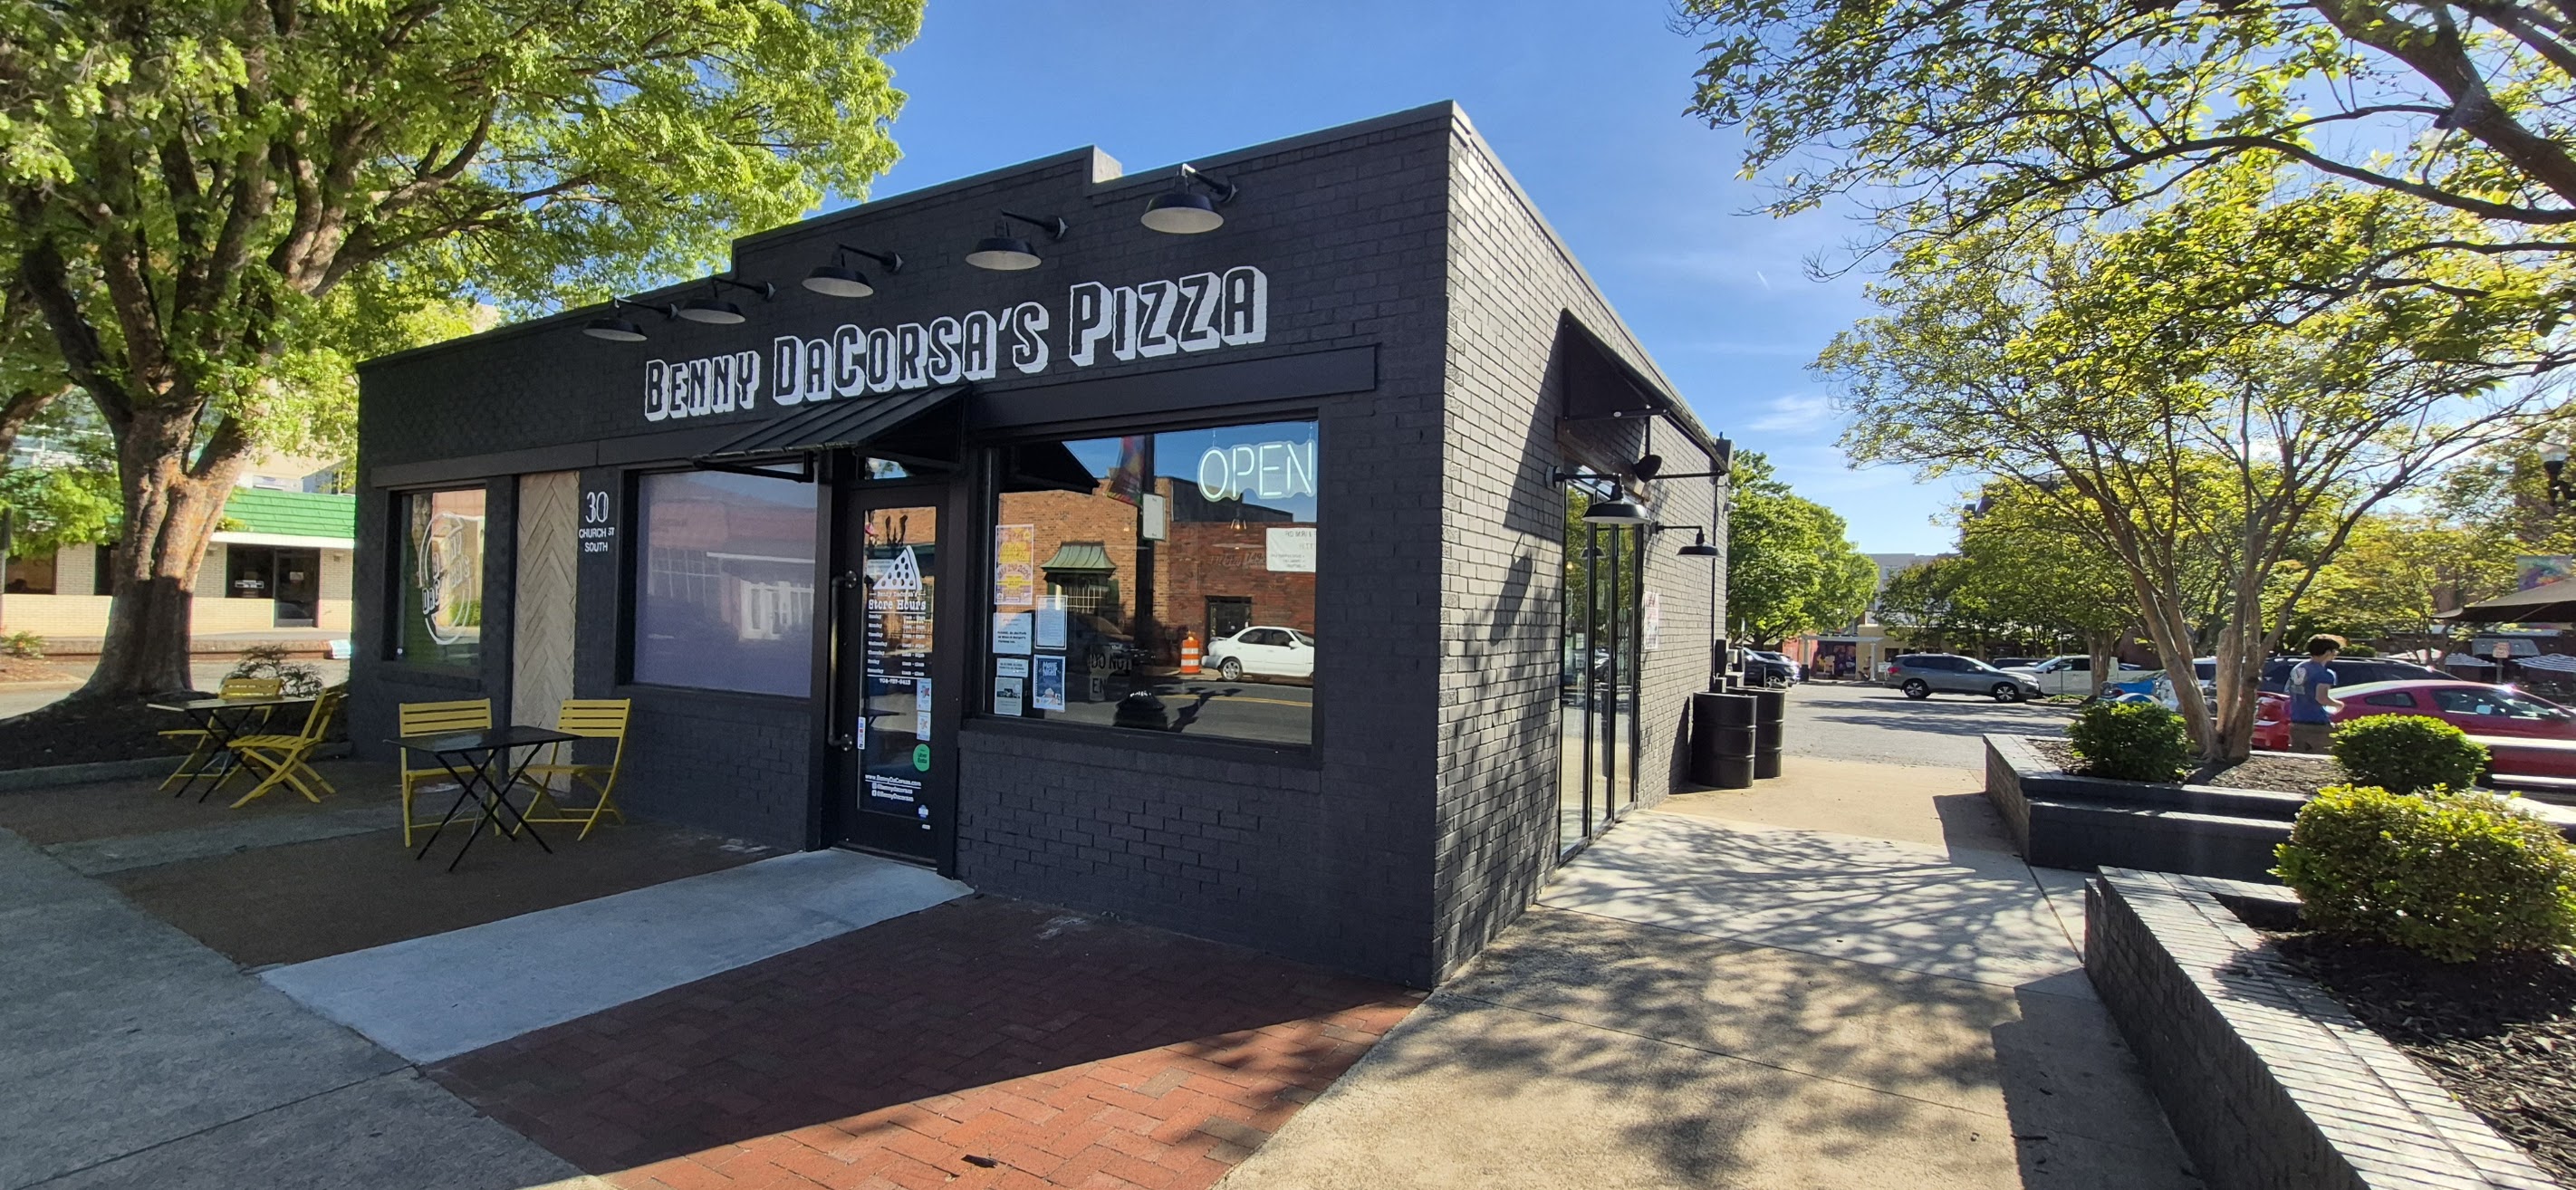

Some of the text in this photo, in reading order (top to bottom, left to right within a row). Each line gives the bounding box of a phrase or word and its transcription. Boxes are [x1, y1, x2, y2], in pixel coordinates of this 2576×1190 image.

[645, 350, 761, 422] BENNY
[1069, 266, 1268, 367] PIZZA
[1200, 442, 1312, 499] OPEN
[585, 491, 609, 523] 30
[579, 527, 615, 538] CHURCH ST
[584, 542, 608, 552] SOUTH
[868, 599, 926, 609] Store Hours
